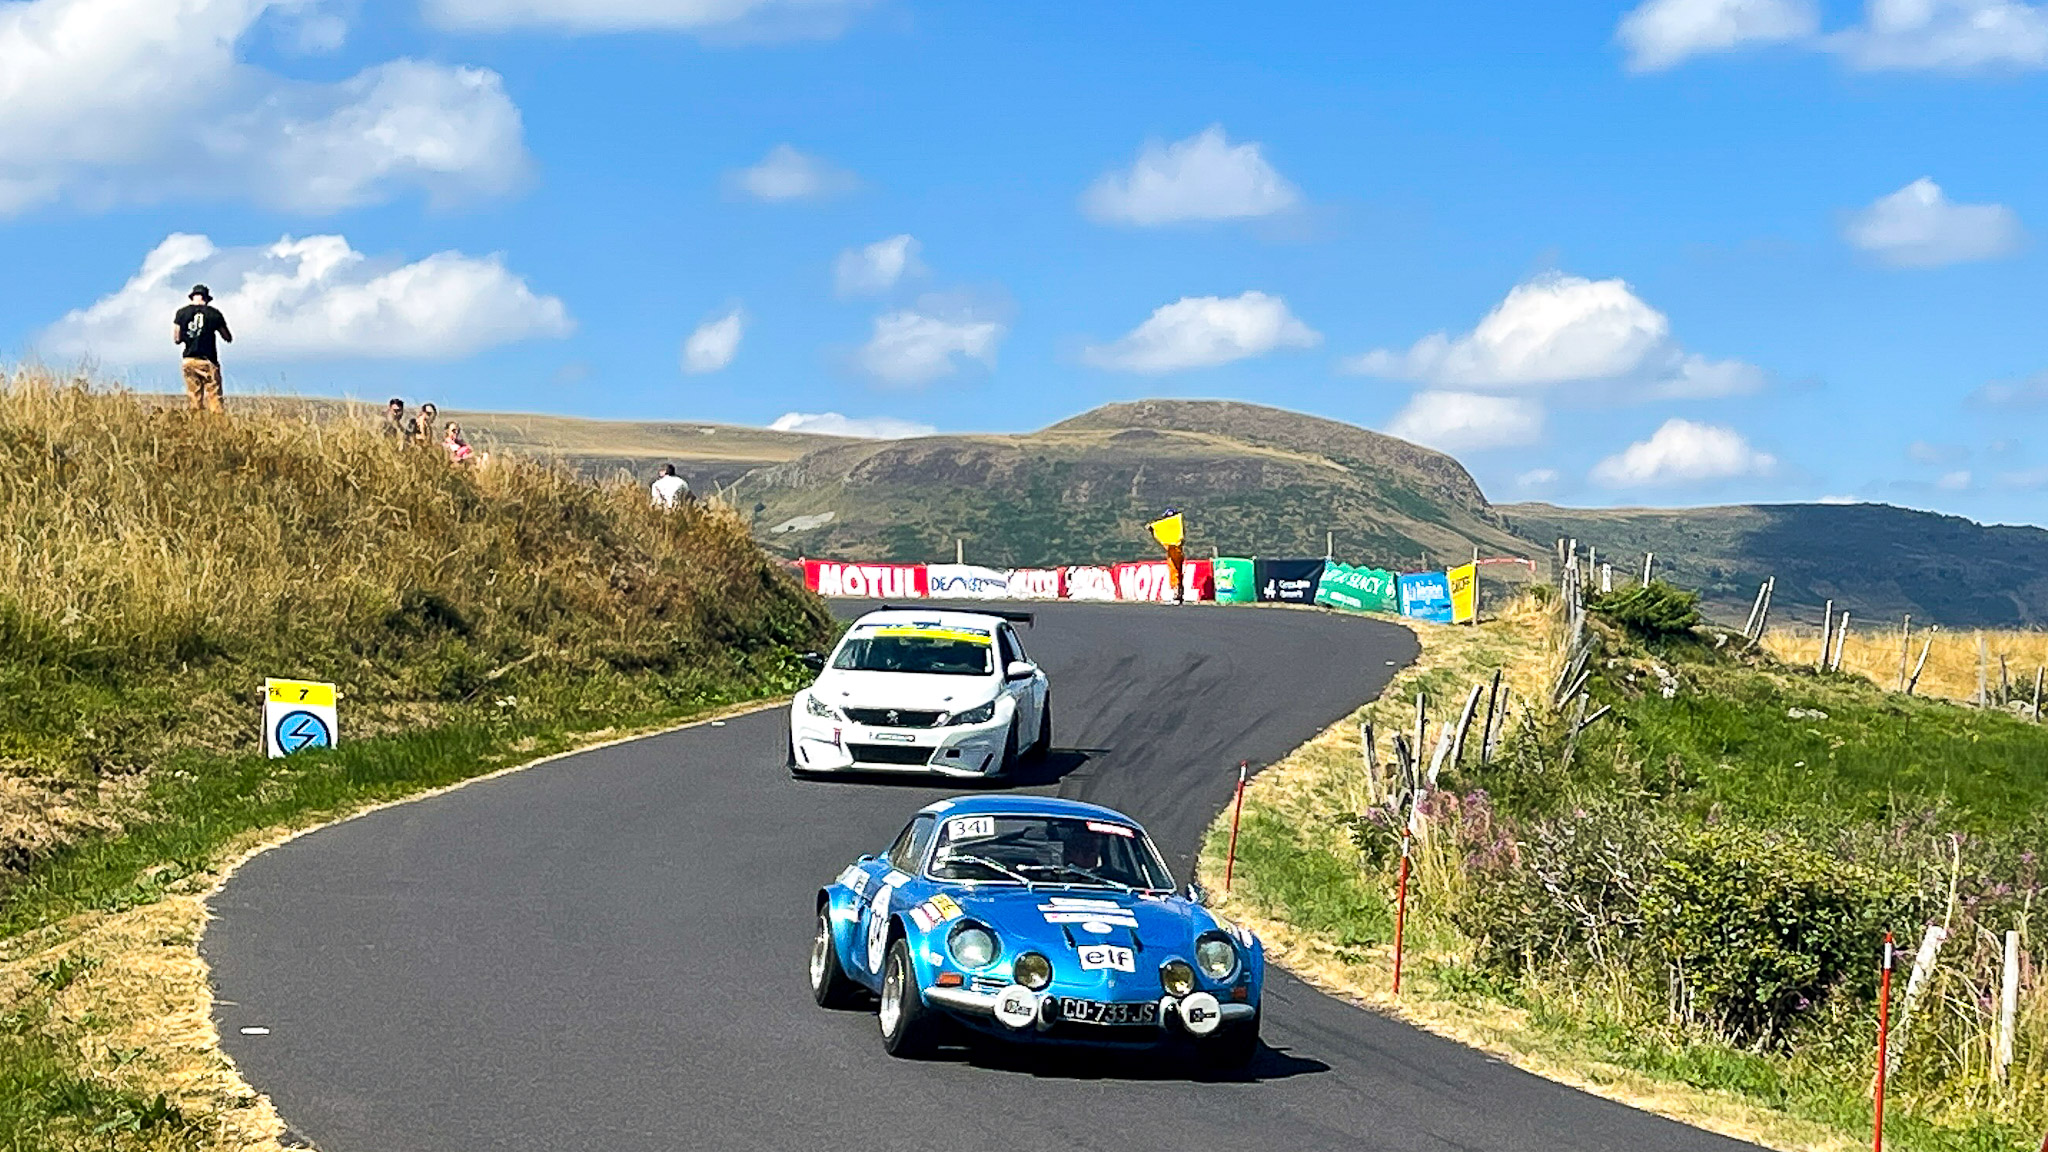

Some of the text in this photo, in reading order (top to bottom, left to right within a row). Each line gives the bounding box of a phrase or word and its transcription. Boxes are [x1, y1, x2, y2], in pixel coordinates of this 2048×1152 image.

[818, 563, 922, 598] MOTUL
[299, 688, 310, 701] 7
[954, 819, 988, 837] 341
[1085, 949, 1130, 967] elf
